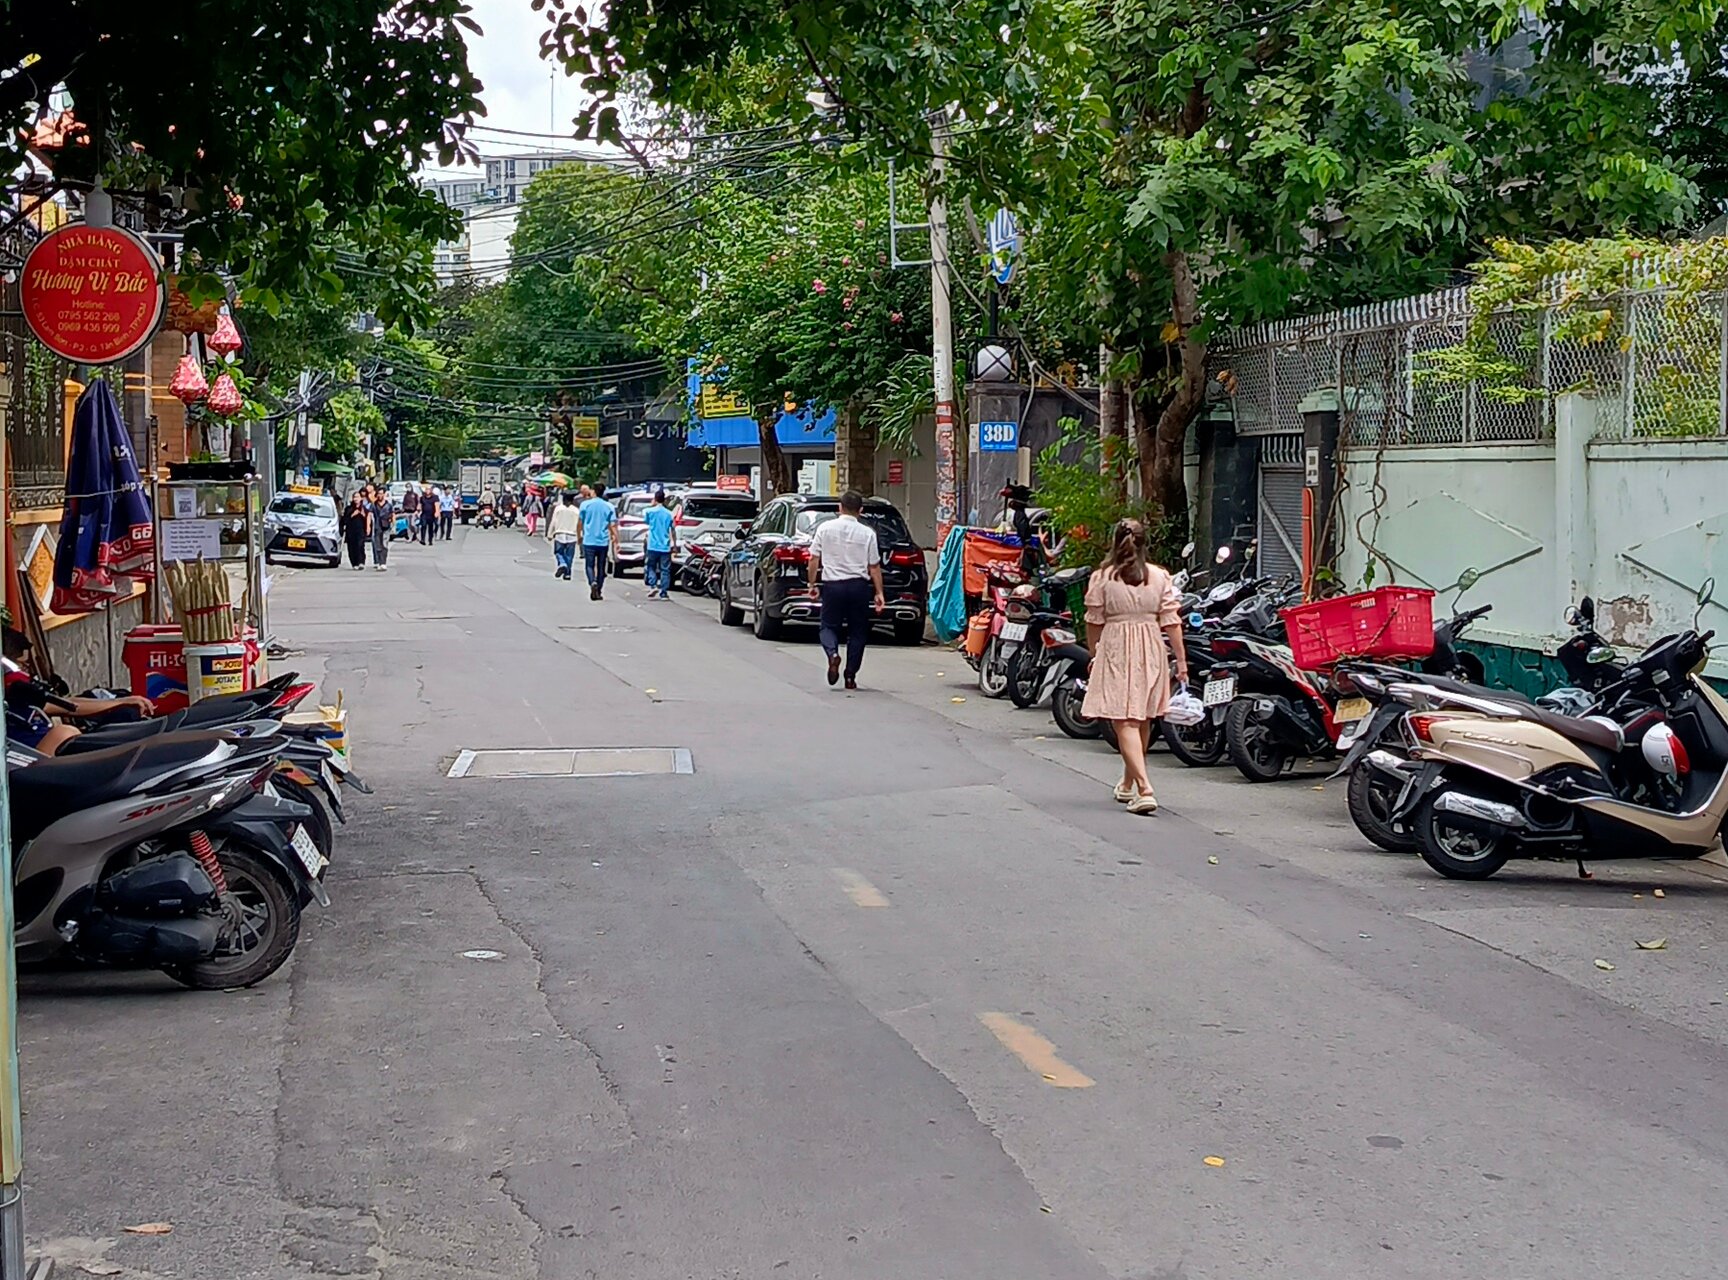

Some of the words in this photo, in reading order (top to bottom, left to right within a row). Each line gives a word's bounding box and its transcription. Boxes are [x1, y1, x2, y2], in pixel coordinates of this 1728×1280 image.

[88, 270, 111, 296] Vị
[114, 270, 148, 293] Bắc
[983, 424, 1015, 442] 38D
